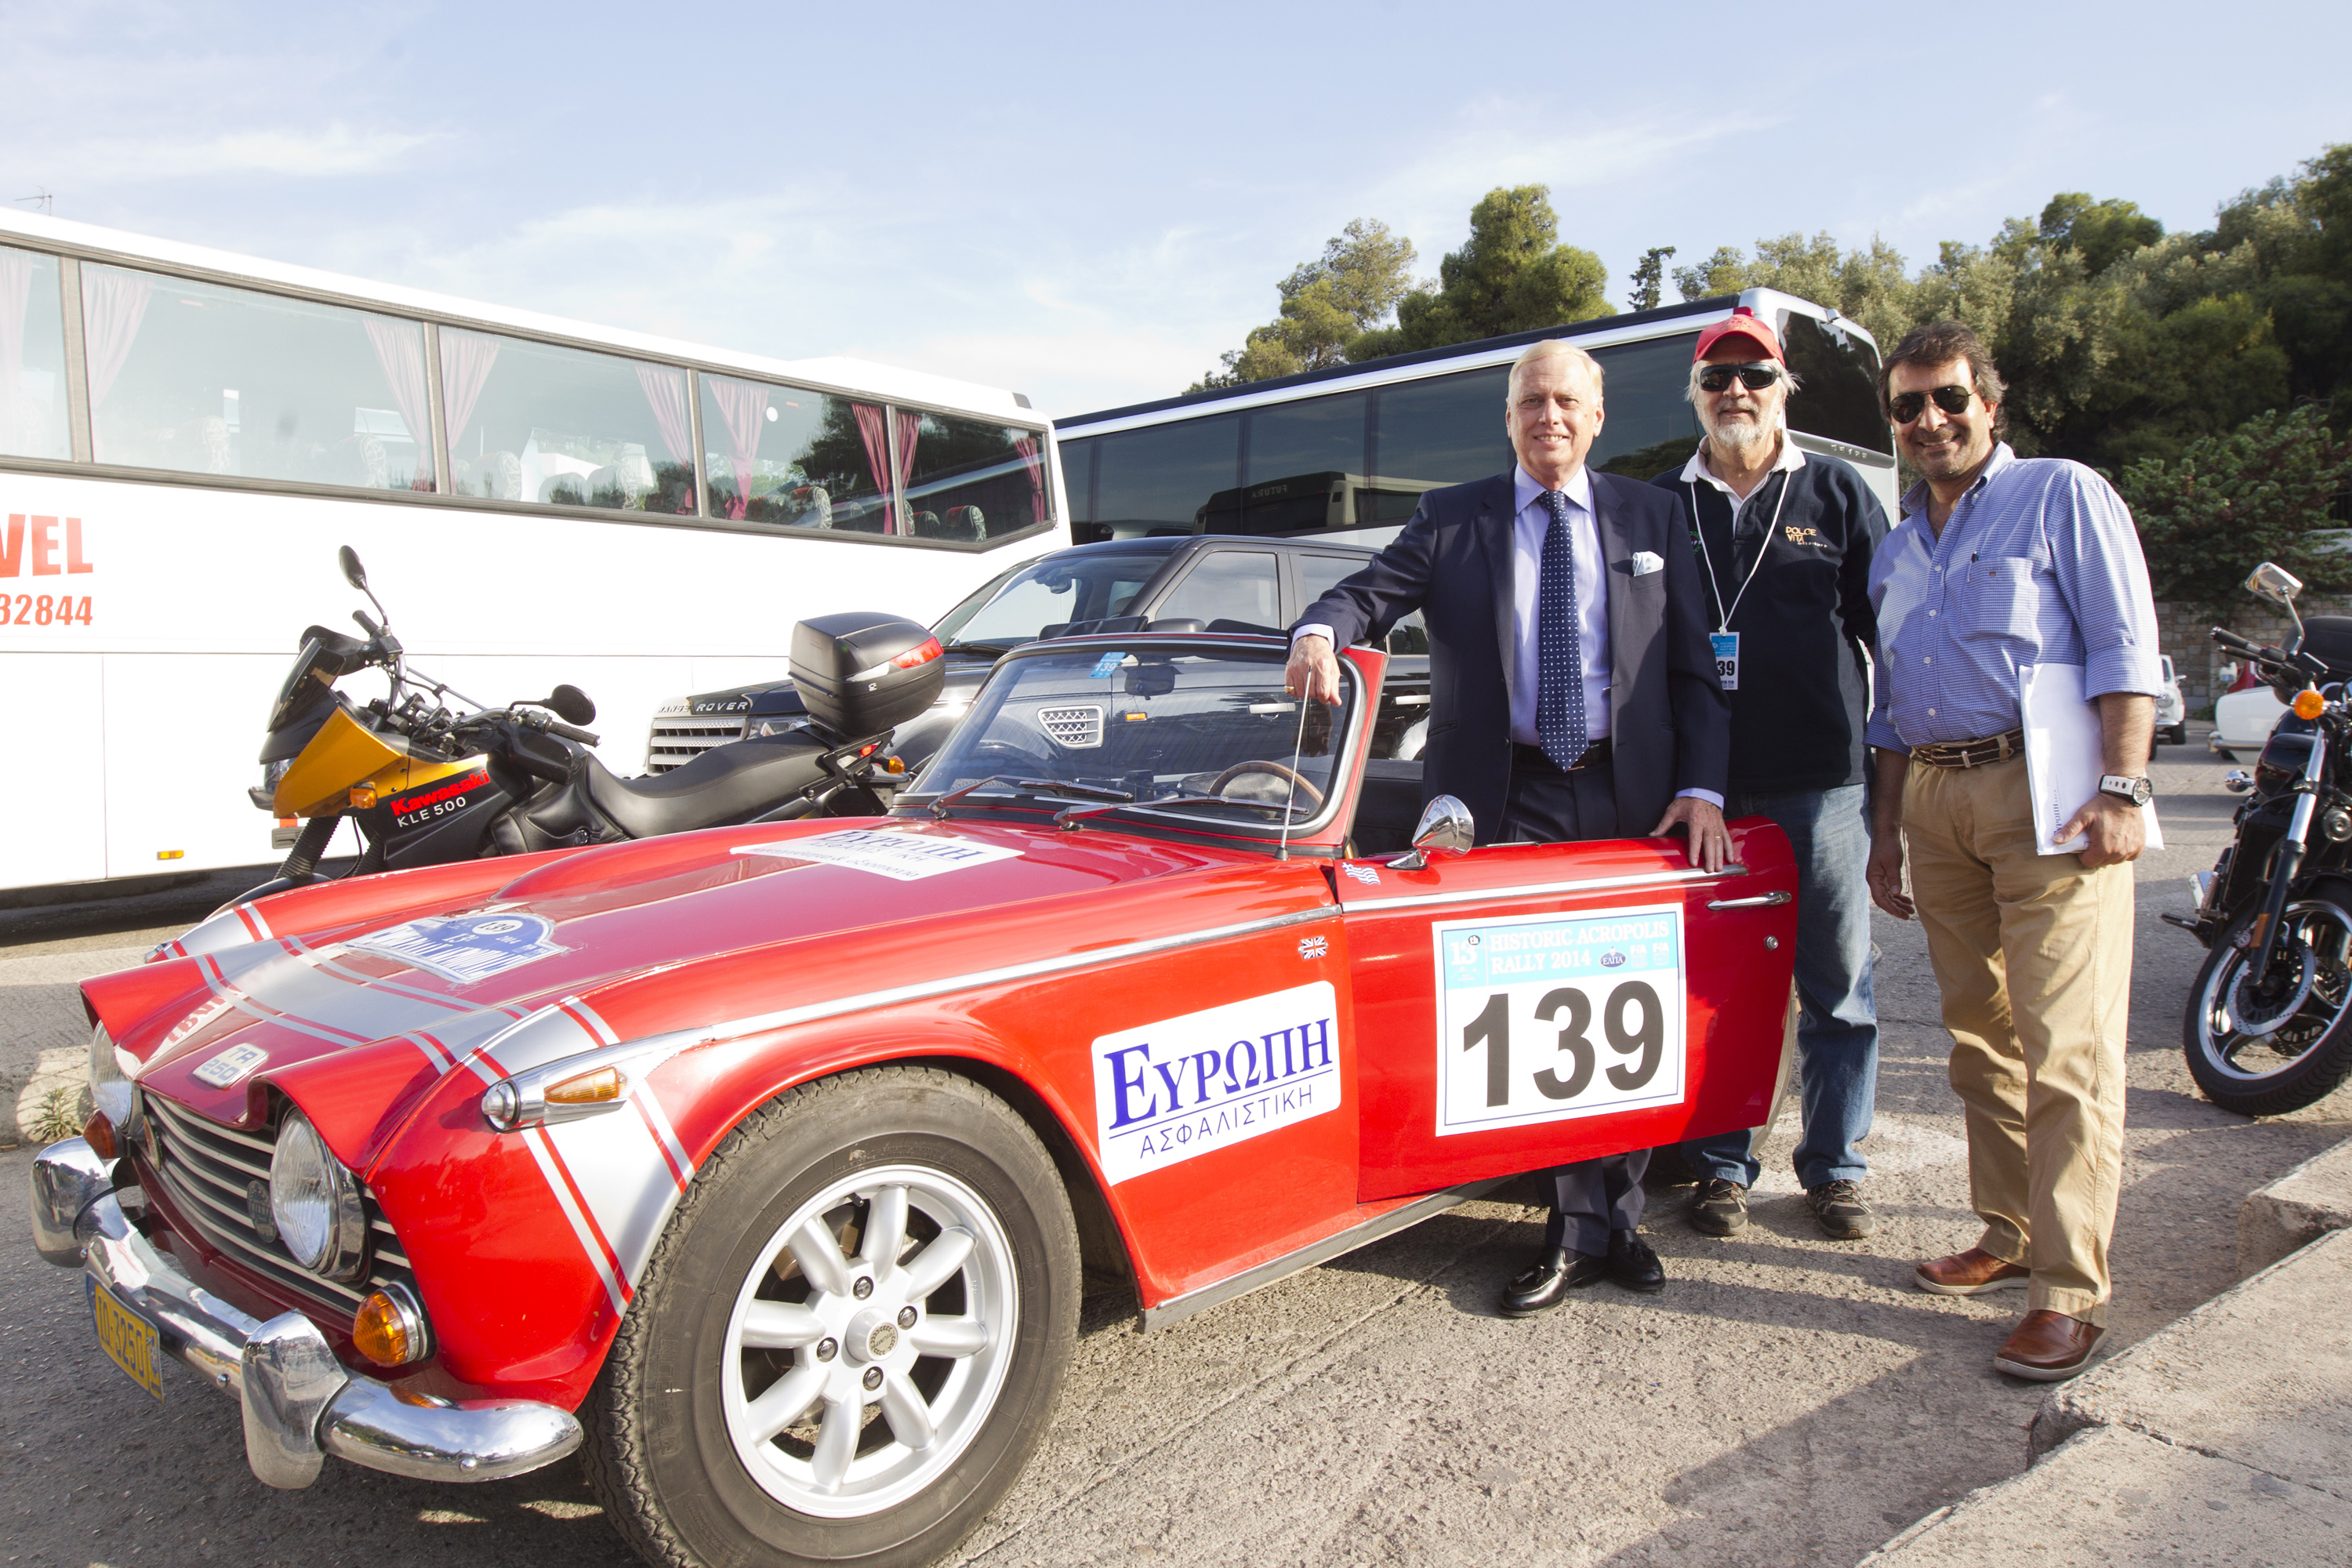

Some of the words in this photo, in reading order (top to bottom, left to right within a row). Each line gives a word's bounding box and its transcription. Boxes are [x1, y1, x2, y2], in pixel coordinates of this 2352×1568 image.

[1785, 526, 1817, 536] DOLCE
[1787, 533, 1805, 545] VITA
[1094, 662, 1118, 672] 139
[659, 705, 691, 713] RANGE
[695, 702, 748, 712] ROVER
[391, 769, 491, 816] Kawasaki
[397, 809, 430, 828] KLE
[433, 797, 466, 815] 500
[2053, 804, 2063, 836] ΥΡΩΠΗ
[477, 921, 517, 932] 139
[1490, 928, 1573, 953] HISTORIC
[1577, 920, 1670, 943] ACROPOLIS
[1490, 953, 1548, 975] RALLY
[1551, 949, 1592, 970] 2014
[228, 1047, 258, 1064] TR
[1463, 980, 1664, 1108] 139
[200, 1058, 240, 1081] 250
[1103, 1018, 1333, 1131] ΕΥΡΩΠΗ
[1139, 1083, 1312, 1160] ΑΣΦΑΛΙΣΤΙΚΗ
[870, 1330, 896, 1351] TRIUMPH
[656, 1338, 679, 1456] MICHELIN
